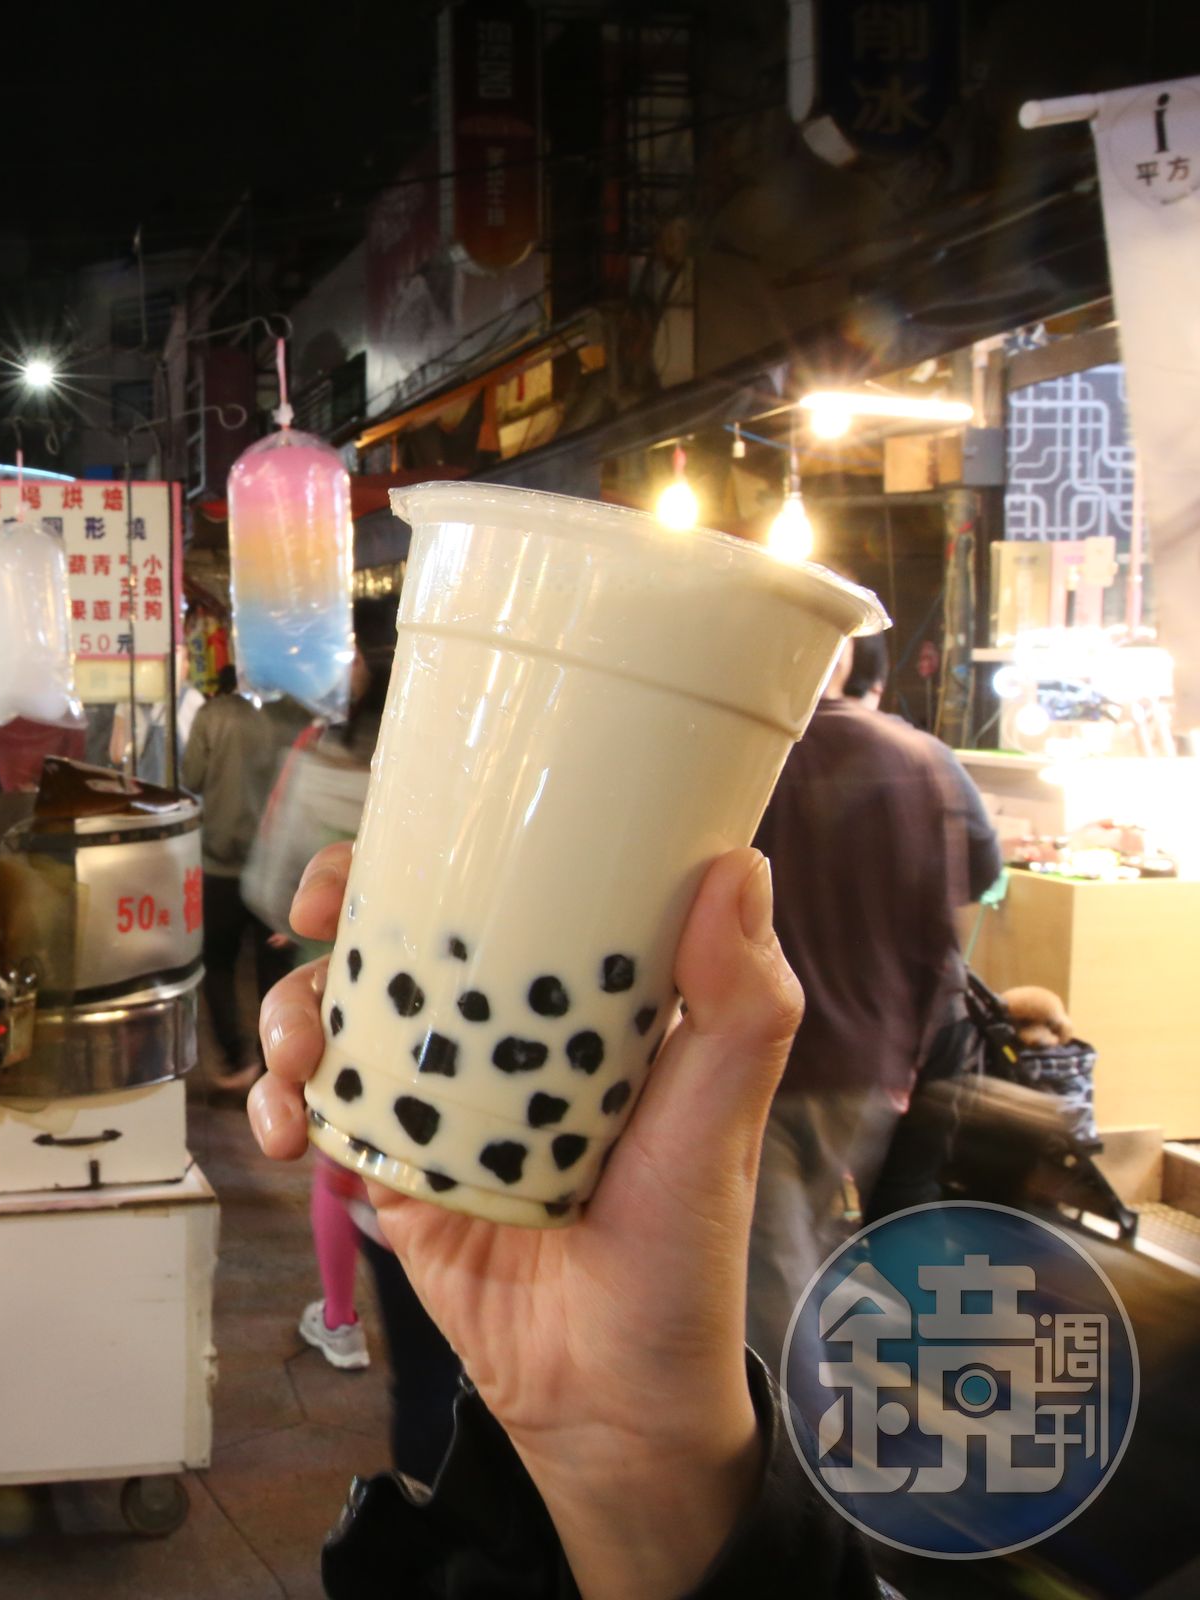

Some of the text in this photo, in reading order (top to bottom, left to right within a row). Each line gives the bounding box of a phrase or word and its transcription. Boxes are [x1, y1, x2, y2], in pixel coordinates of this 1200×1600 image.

[1135, 156, 1190, 187] 平方
[143, 553, 163, 621] 小熱狗
